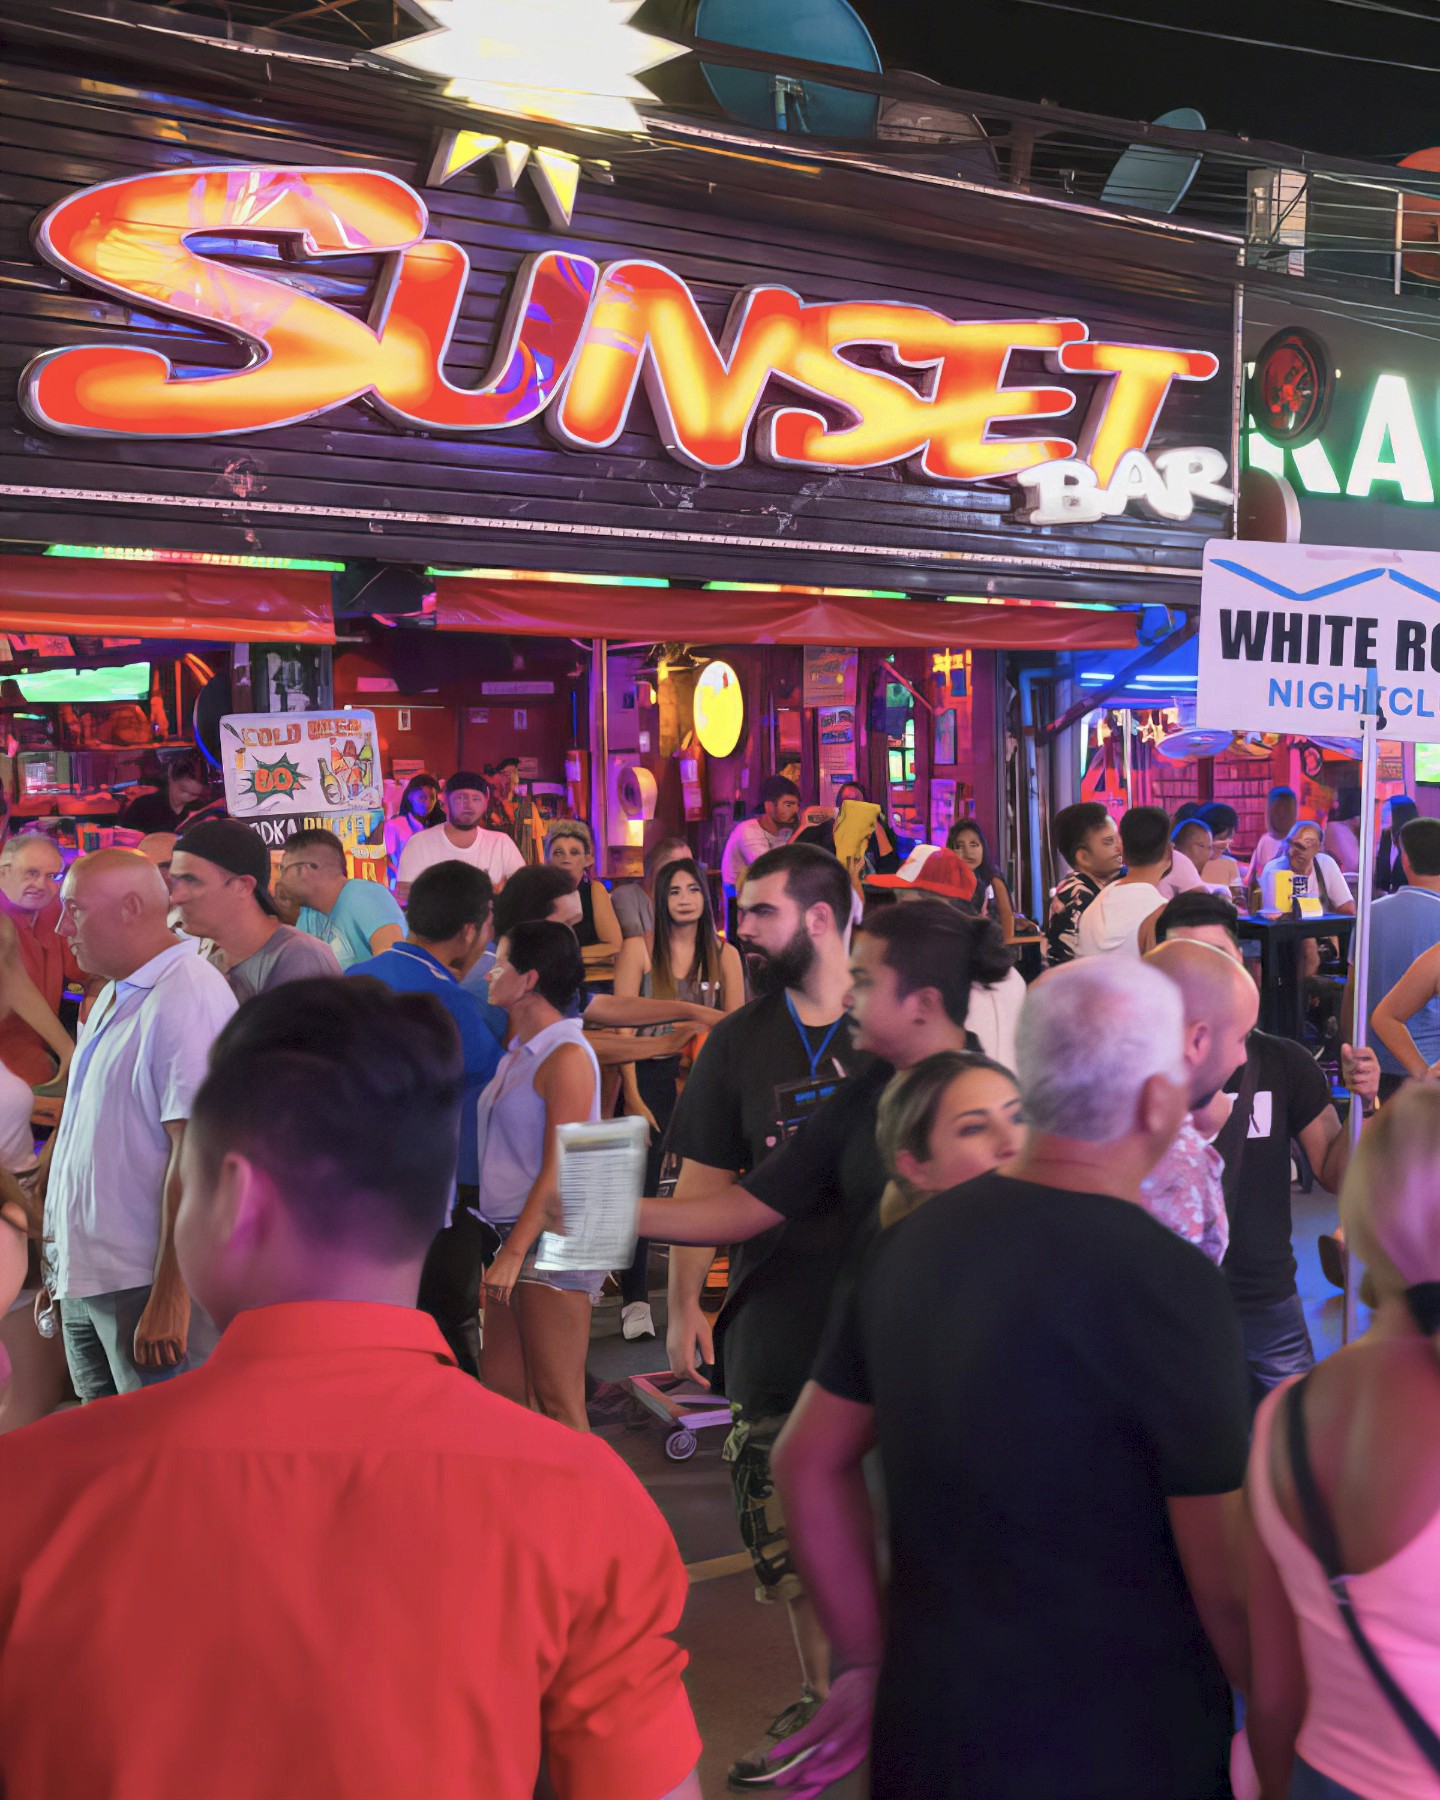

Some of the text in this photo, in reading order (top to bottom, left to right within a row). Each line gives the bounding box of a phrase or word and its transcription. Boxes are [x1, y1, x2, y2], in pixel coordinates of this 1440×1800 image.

[22, 166, 1221, 482] SUNSET
[1017, 446, 1239, 525] BAR
[1219, 608, 1379, 668] WHITE
